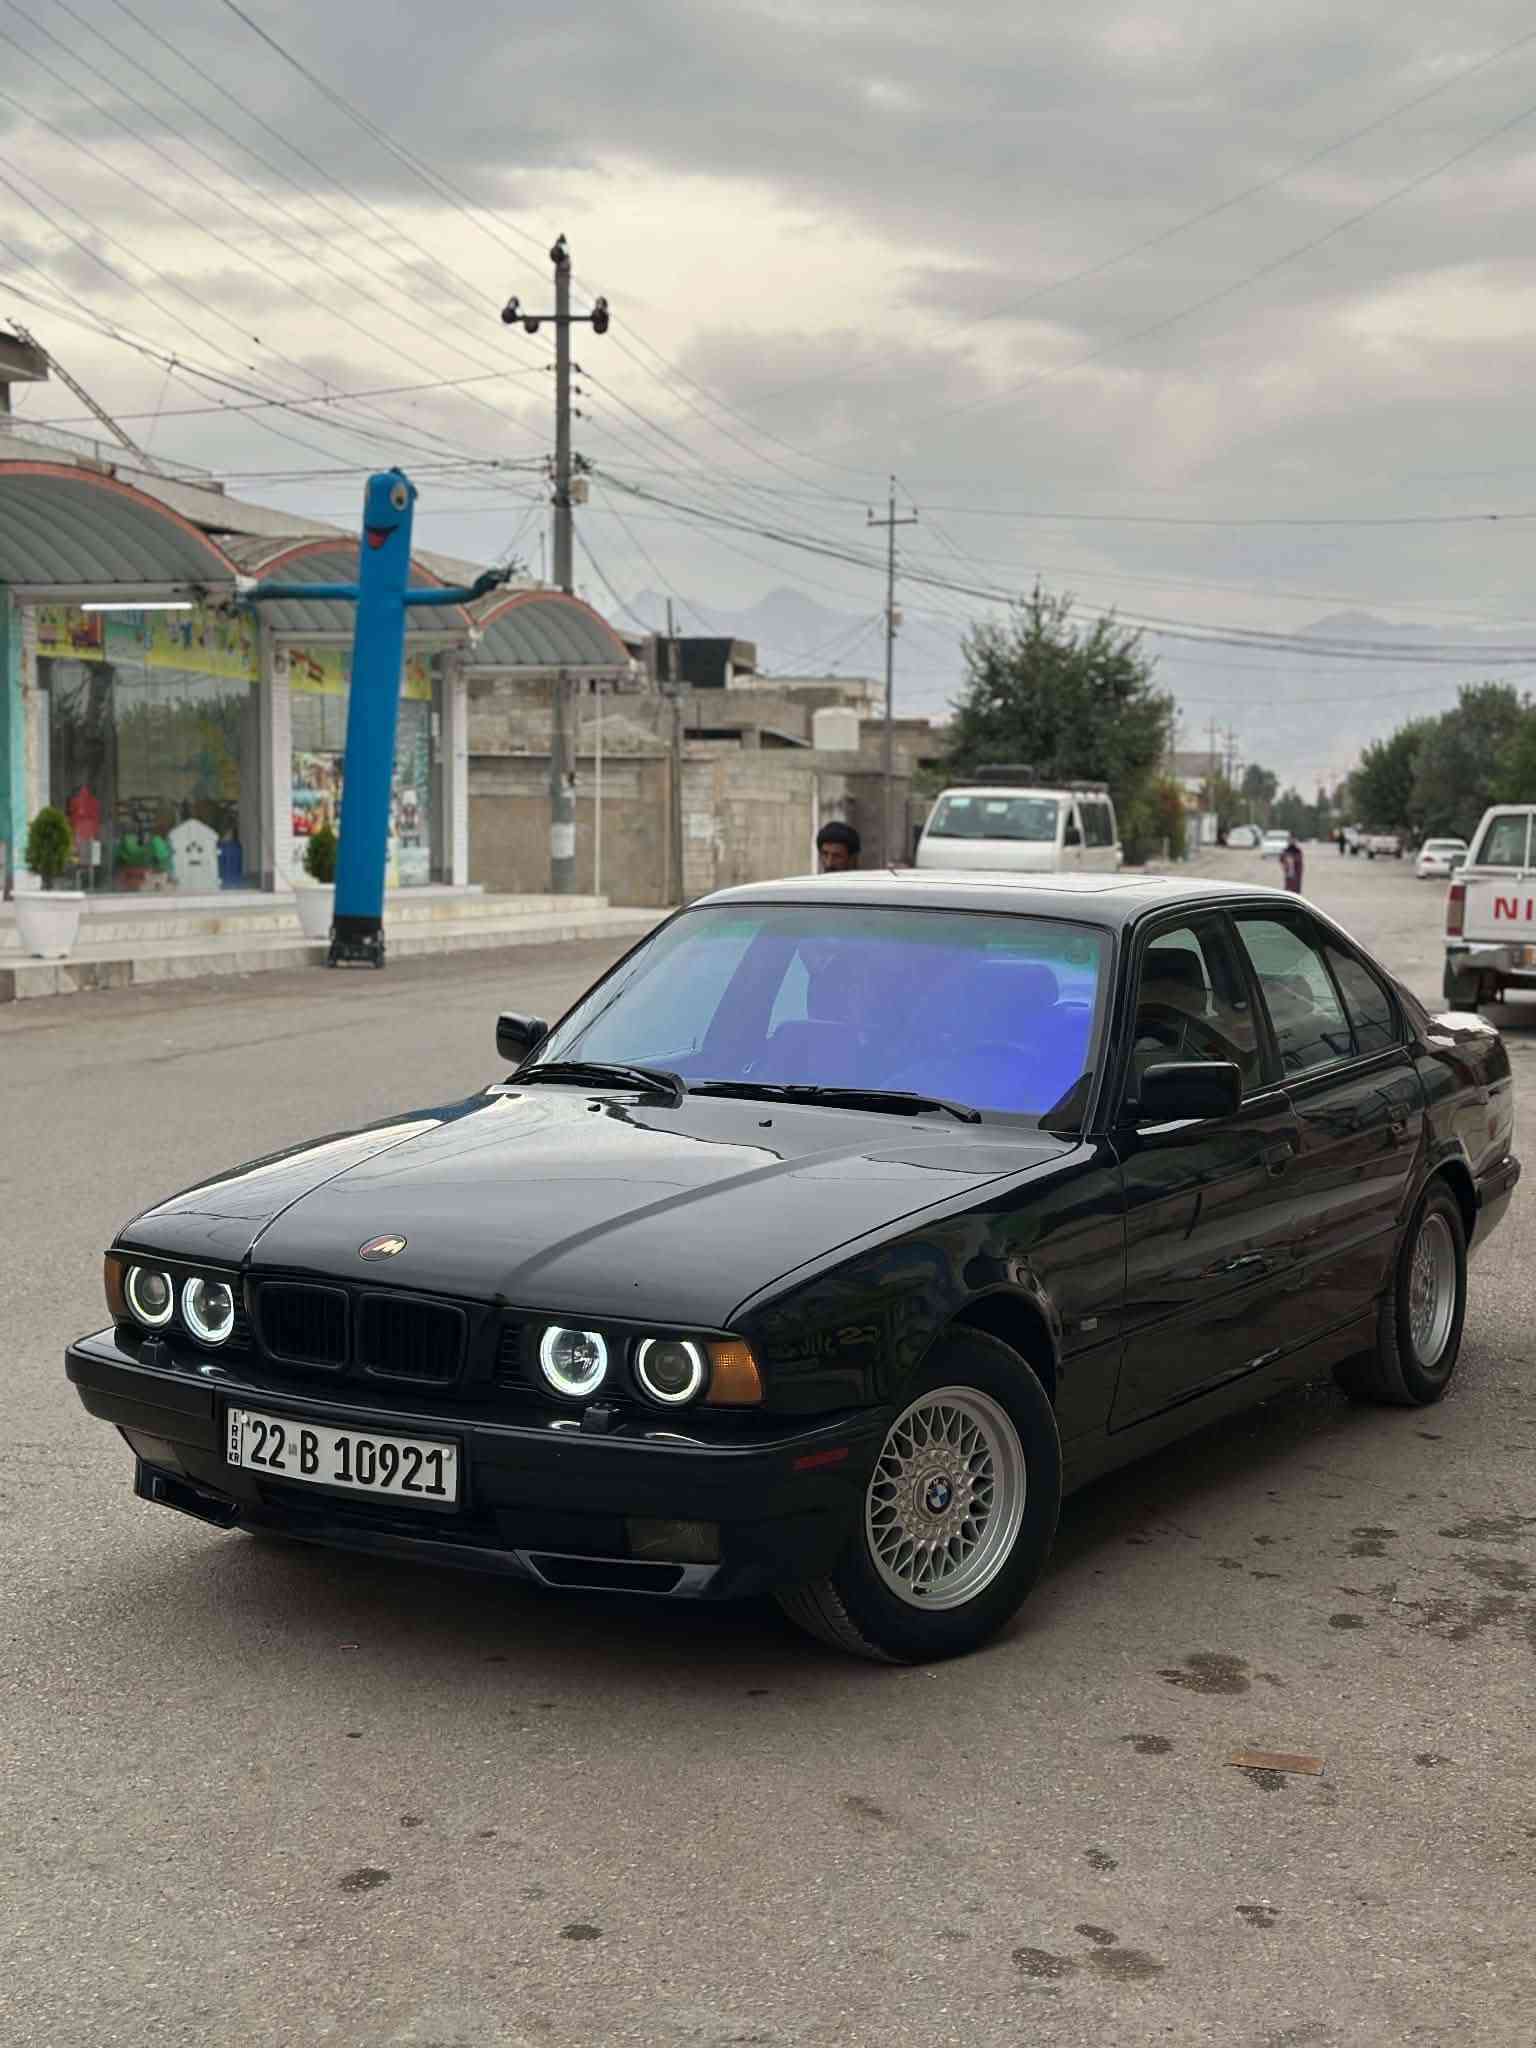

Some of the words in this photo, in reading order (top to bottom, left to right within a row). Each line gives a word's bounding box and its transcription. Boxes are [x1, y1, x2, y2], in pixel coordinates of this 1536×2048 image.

[250, 1420, 285, 1469] 22
[300, 1430, 319, 1474] B
[334, 1437, 446, 1495] 10921
